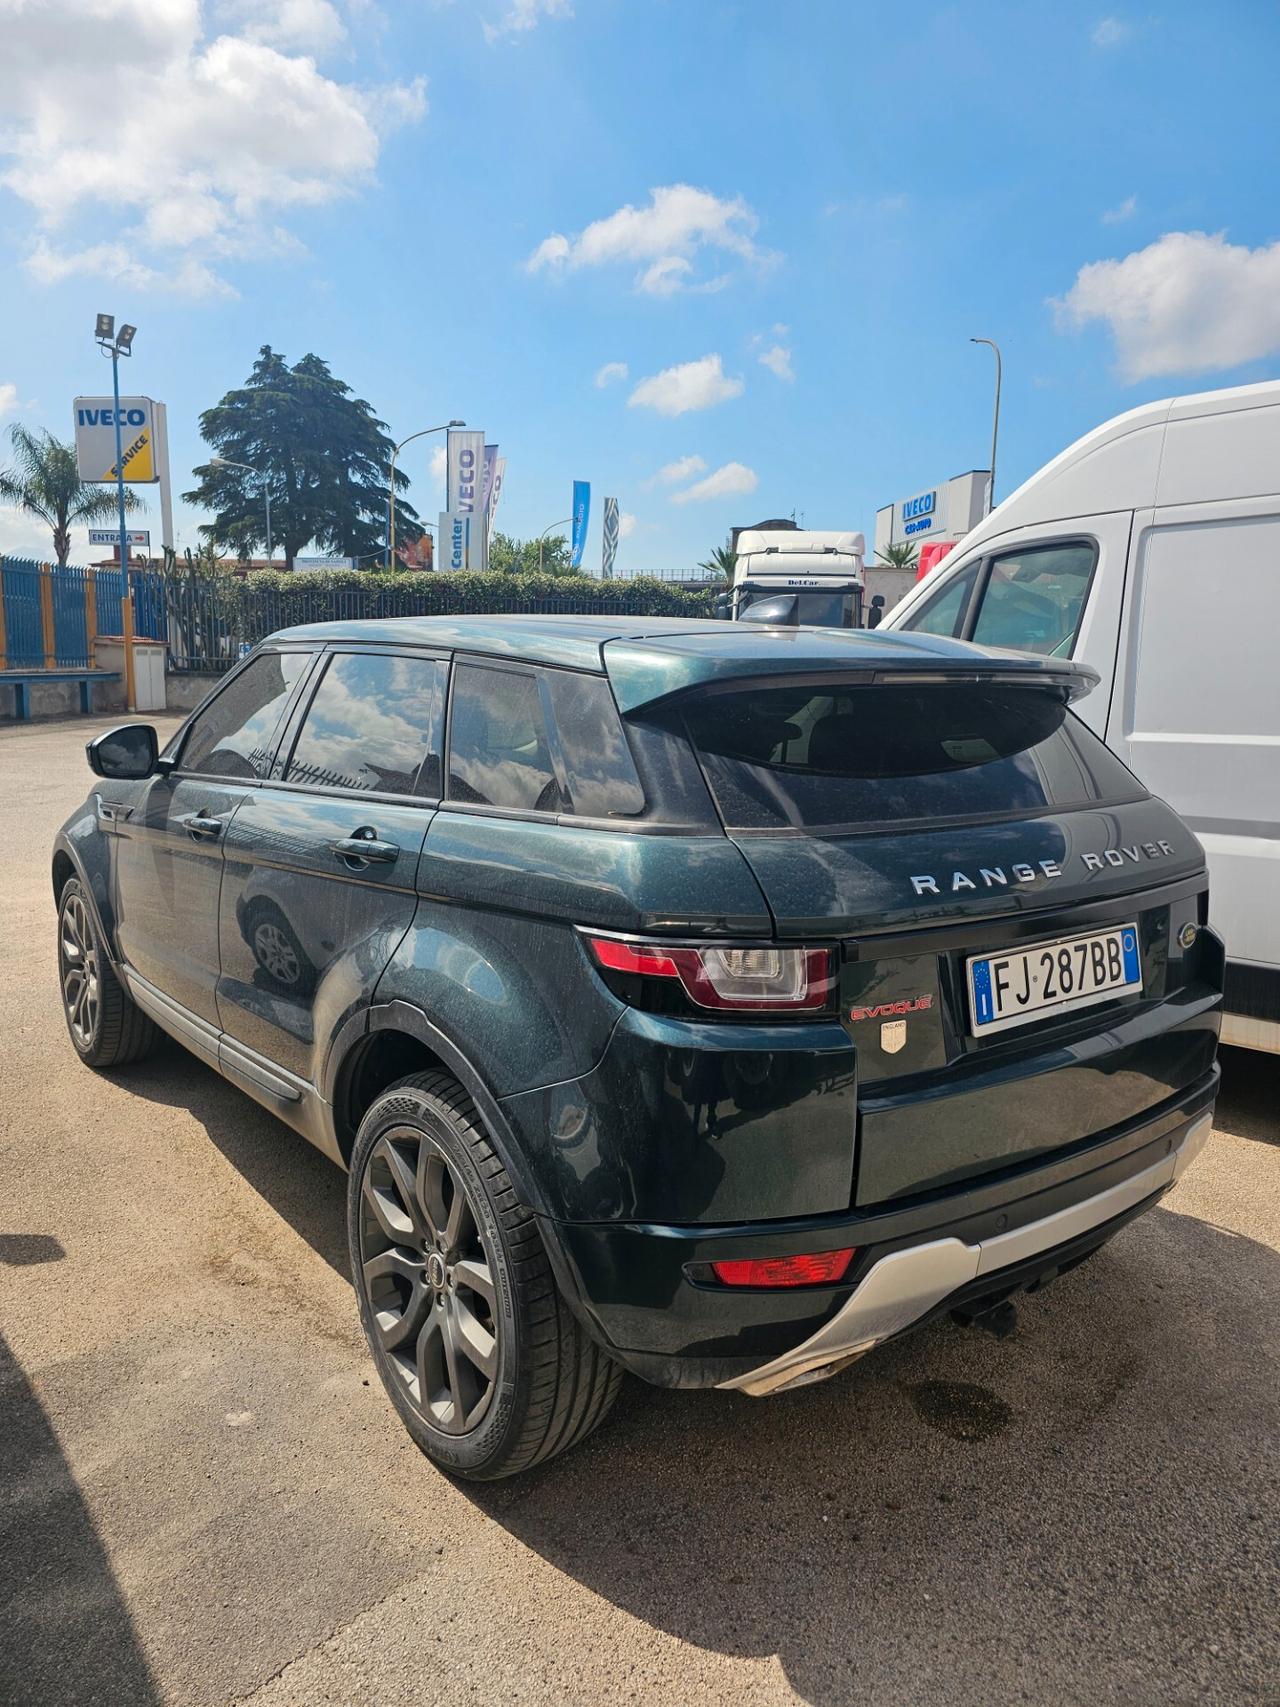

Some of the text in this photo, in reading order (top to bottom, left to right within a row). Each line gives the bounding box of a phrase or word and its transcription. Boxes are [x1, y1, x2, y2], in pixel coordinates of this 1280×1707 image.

[78, 409, 145, 426] IVECO
[110, 434, 149, 477] SRVICE
[903, 494, 932, 519] IVECO
[92, 533, 133, 542] ENTRAA
[451, 518, 463, 569] Center
[909, 839, 1175, 895] RANGE ROVER
[850, 994, 933, 1021] EVOQUE
